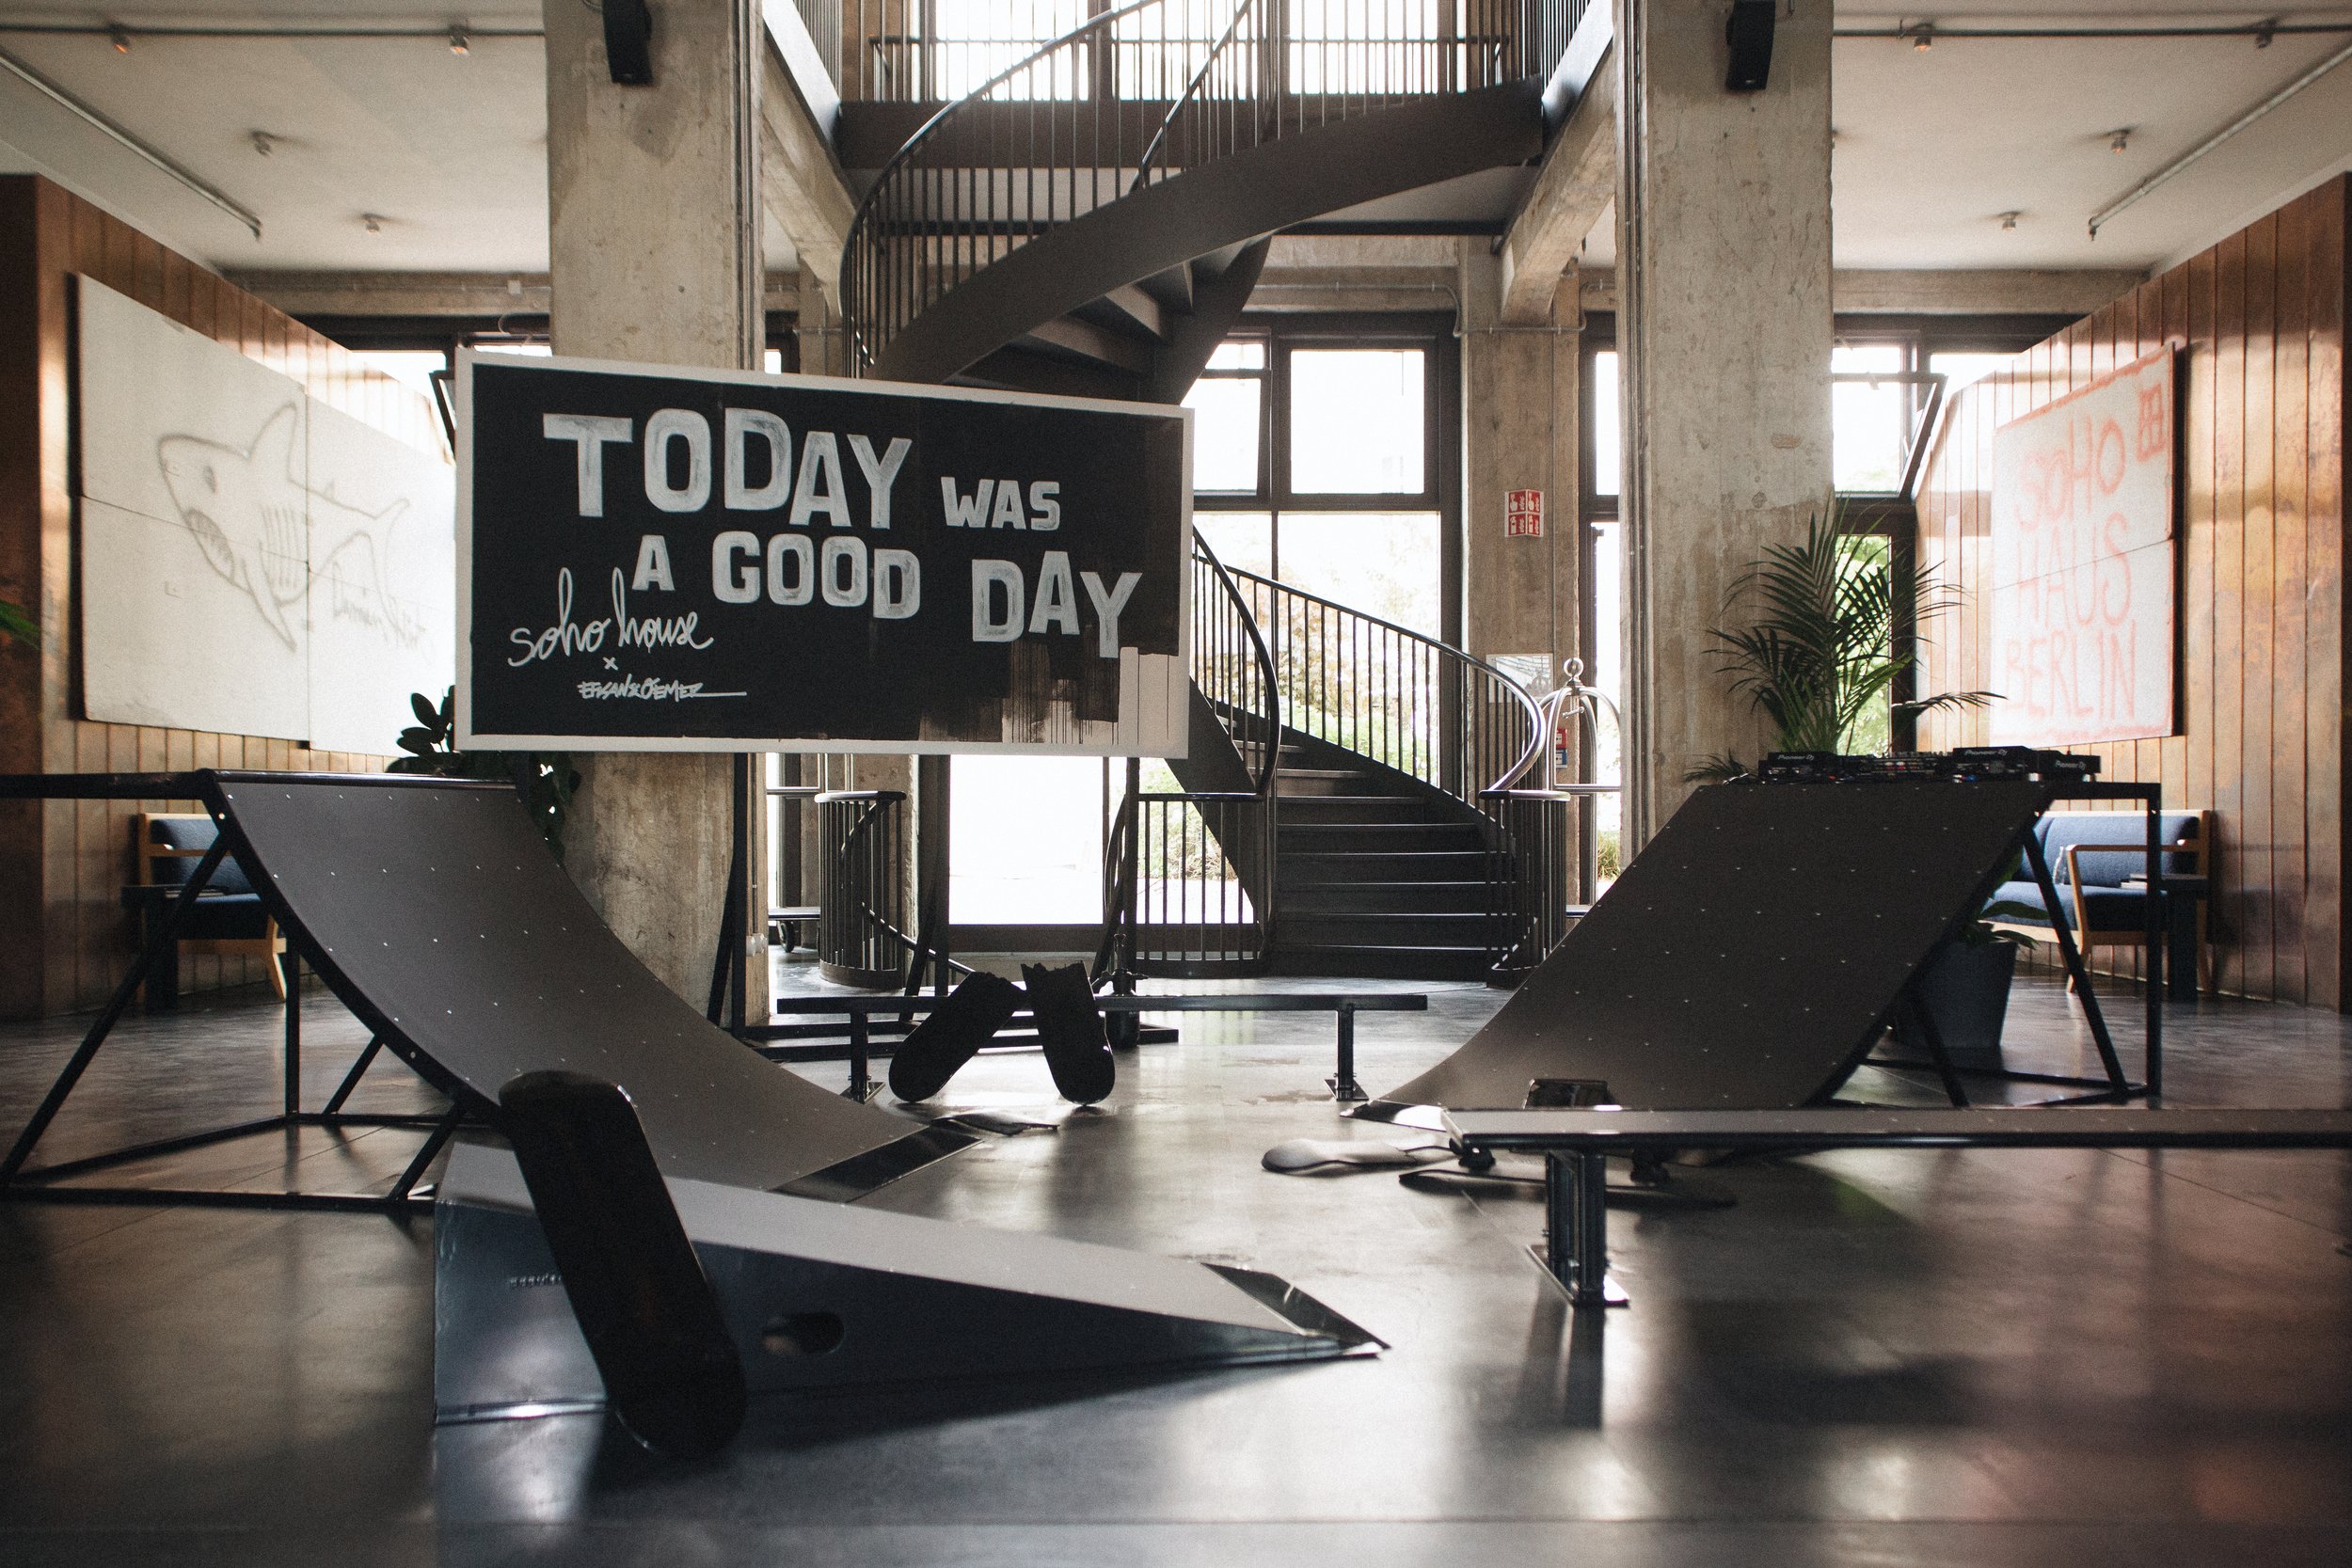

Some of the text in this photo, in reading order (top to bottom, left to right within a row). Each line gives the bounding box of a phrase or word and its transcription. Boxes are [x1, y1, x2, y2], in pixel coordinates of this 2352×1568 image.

[542, 407, 1061, 531] TODAY WAS
[2014, 413, 2126, 534] SOHO
[507, 567, 714, 667] soho house
[632, 531, 1143, 658] A GOOD DAY
[2016, 511, 2133, 629] HAUS
[2003, 620, 2137, 722] BERLIN
